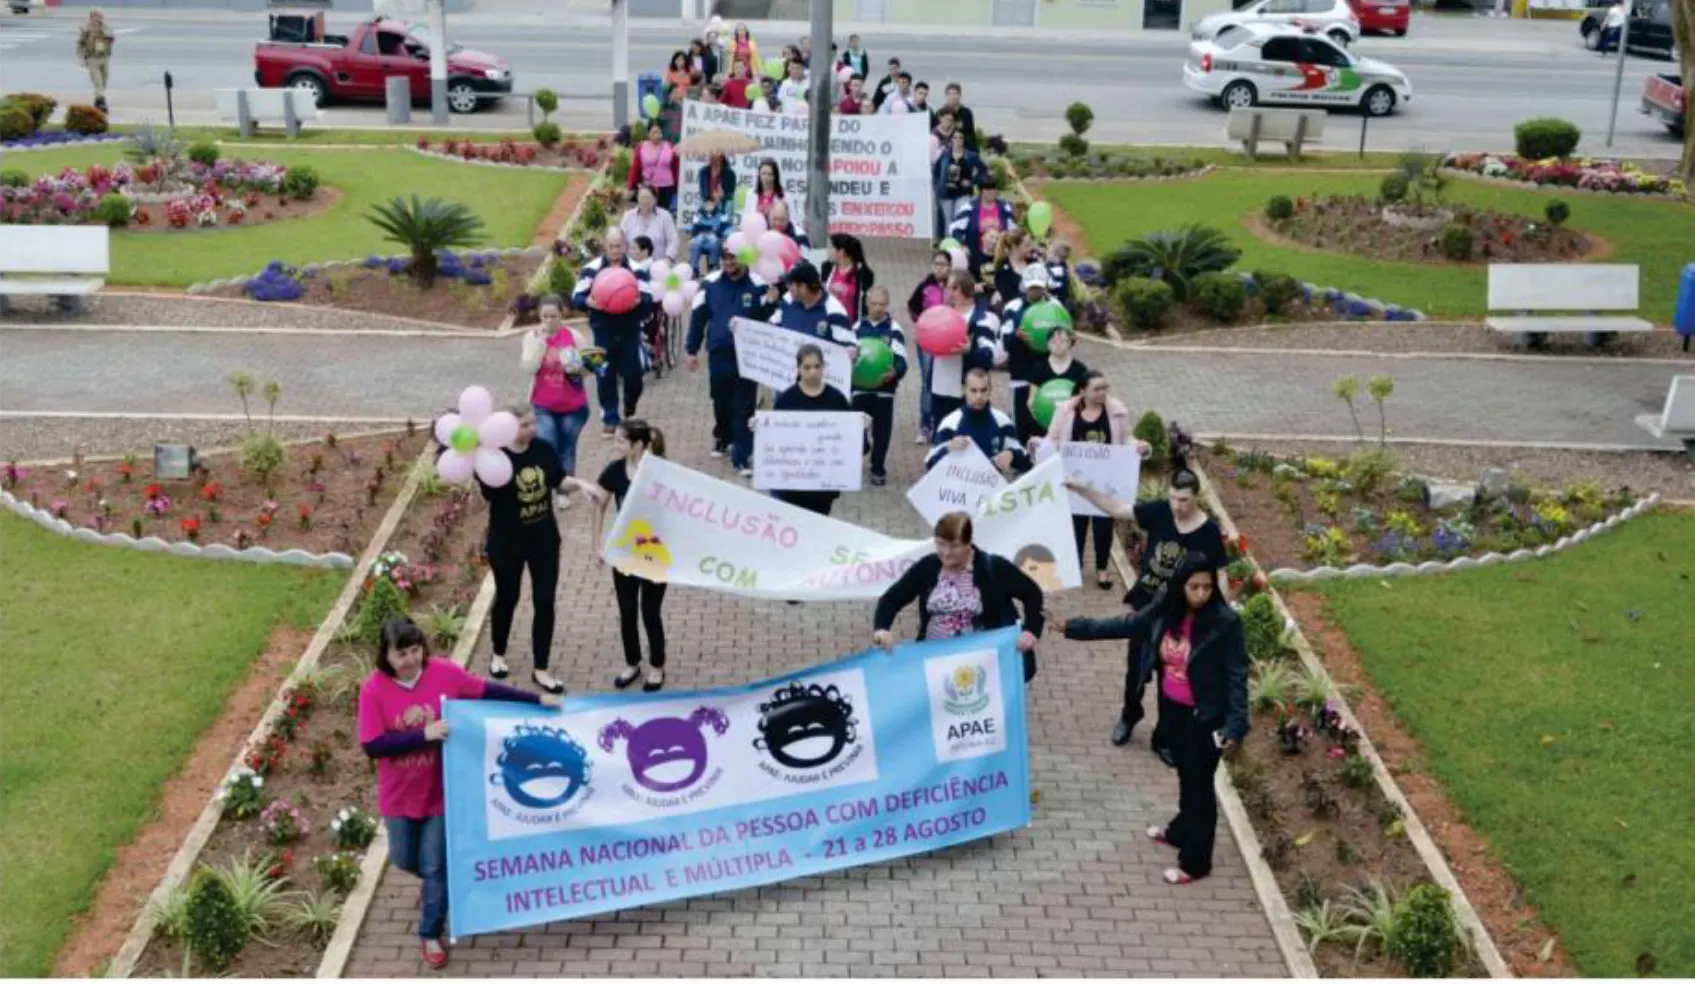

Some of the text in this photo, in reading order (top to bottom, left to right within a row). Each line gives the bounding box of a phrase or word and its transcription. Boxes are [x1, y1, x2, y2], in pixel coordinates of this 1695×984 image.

[686, 103, 698, 119] A
[703, 107, 741, 126] APAE
[838, 119, 861, 133] DO
[828, 139, 876, 155] ENDO
[880, 140, 893, 155] O
[781, 157, 808, 173] NO
[886, 161, 898, 175] A
[879, 180, 891, 196] E
[938, 487, 967, 505] VIVA
[645, 480, 800, 549] INCLUSÃO
[699, 556, 758, 589] COM
[947, 717, 997, 741] APAE
[473, 769, 1009, 882] SEMANA NACIONAL DA PESSOA COM DEFICIÊNCIA
[506, 872, 656, 914] INTELECTUAL
[664, 868, 680, 888] E
[685, 847, 794, 885] MÚLTIPLA
[823, 837, 848, 860] 21
[853, 837, 867, 852] a
[872, 827, 898, 849] 28
[903, 807, 987, 843] AGOSTO
